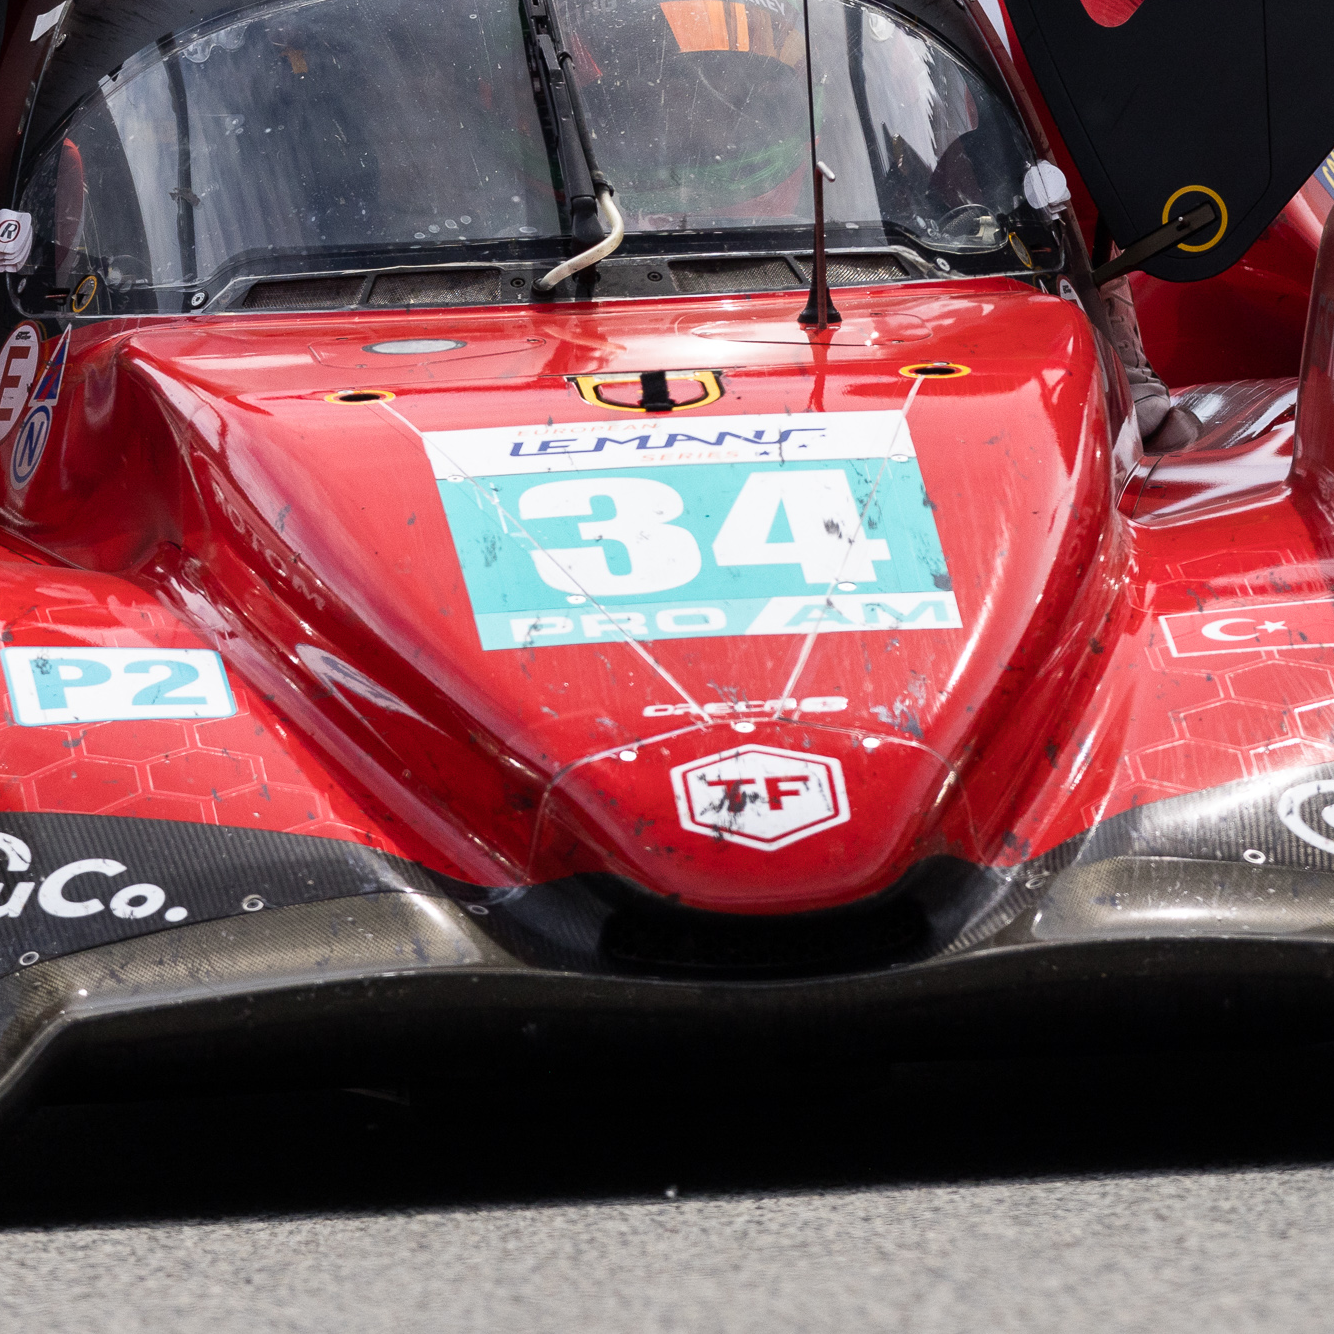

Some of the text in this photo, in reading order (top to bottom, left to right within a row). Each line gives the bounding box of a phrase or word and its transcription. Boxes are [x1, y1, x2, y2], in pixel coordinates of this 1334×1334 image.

[17, 420, 45, 467] N
[517, 422, 658, 437] EUROPEAN
[638, 450, 740, 463] SERIES
[517, 468, 893, 598] 34
[509, 599, 952, 645] PRO AM
[28, 657, 209, 712] P2
[706, 774, 810, 813] TF
